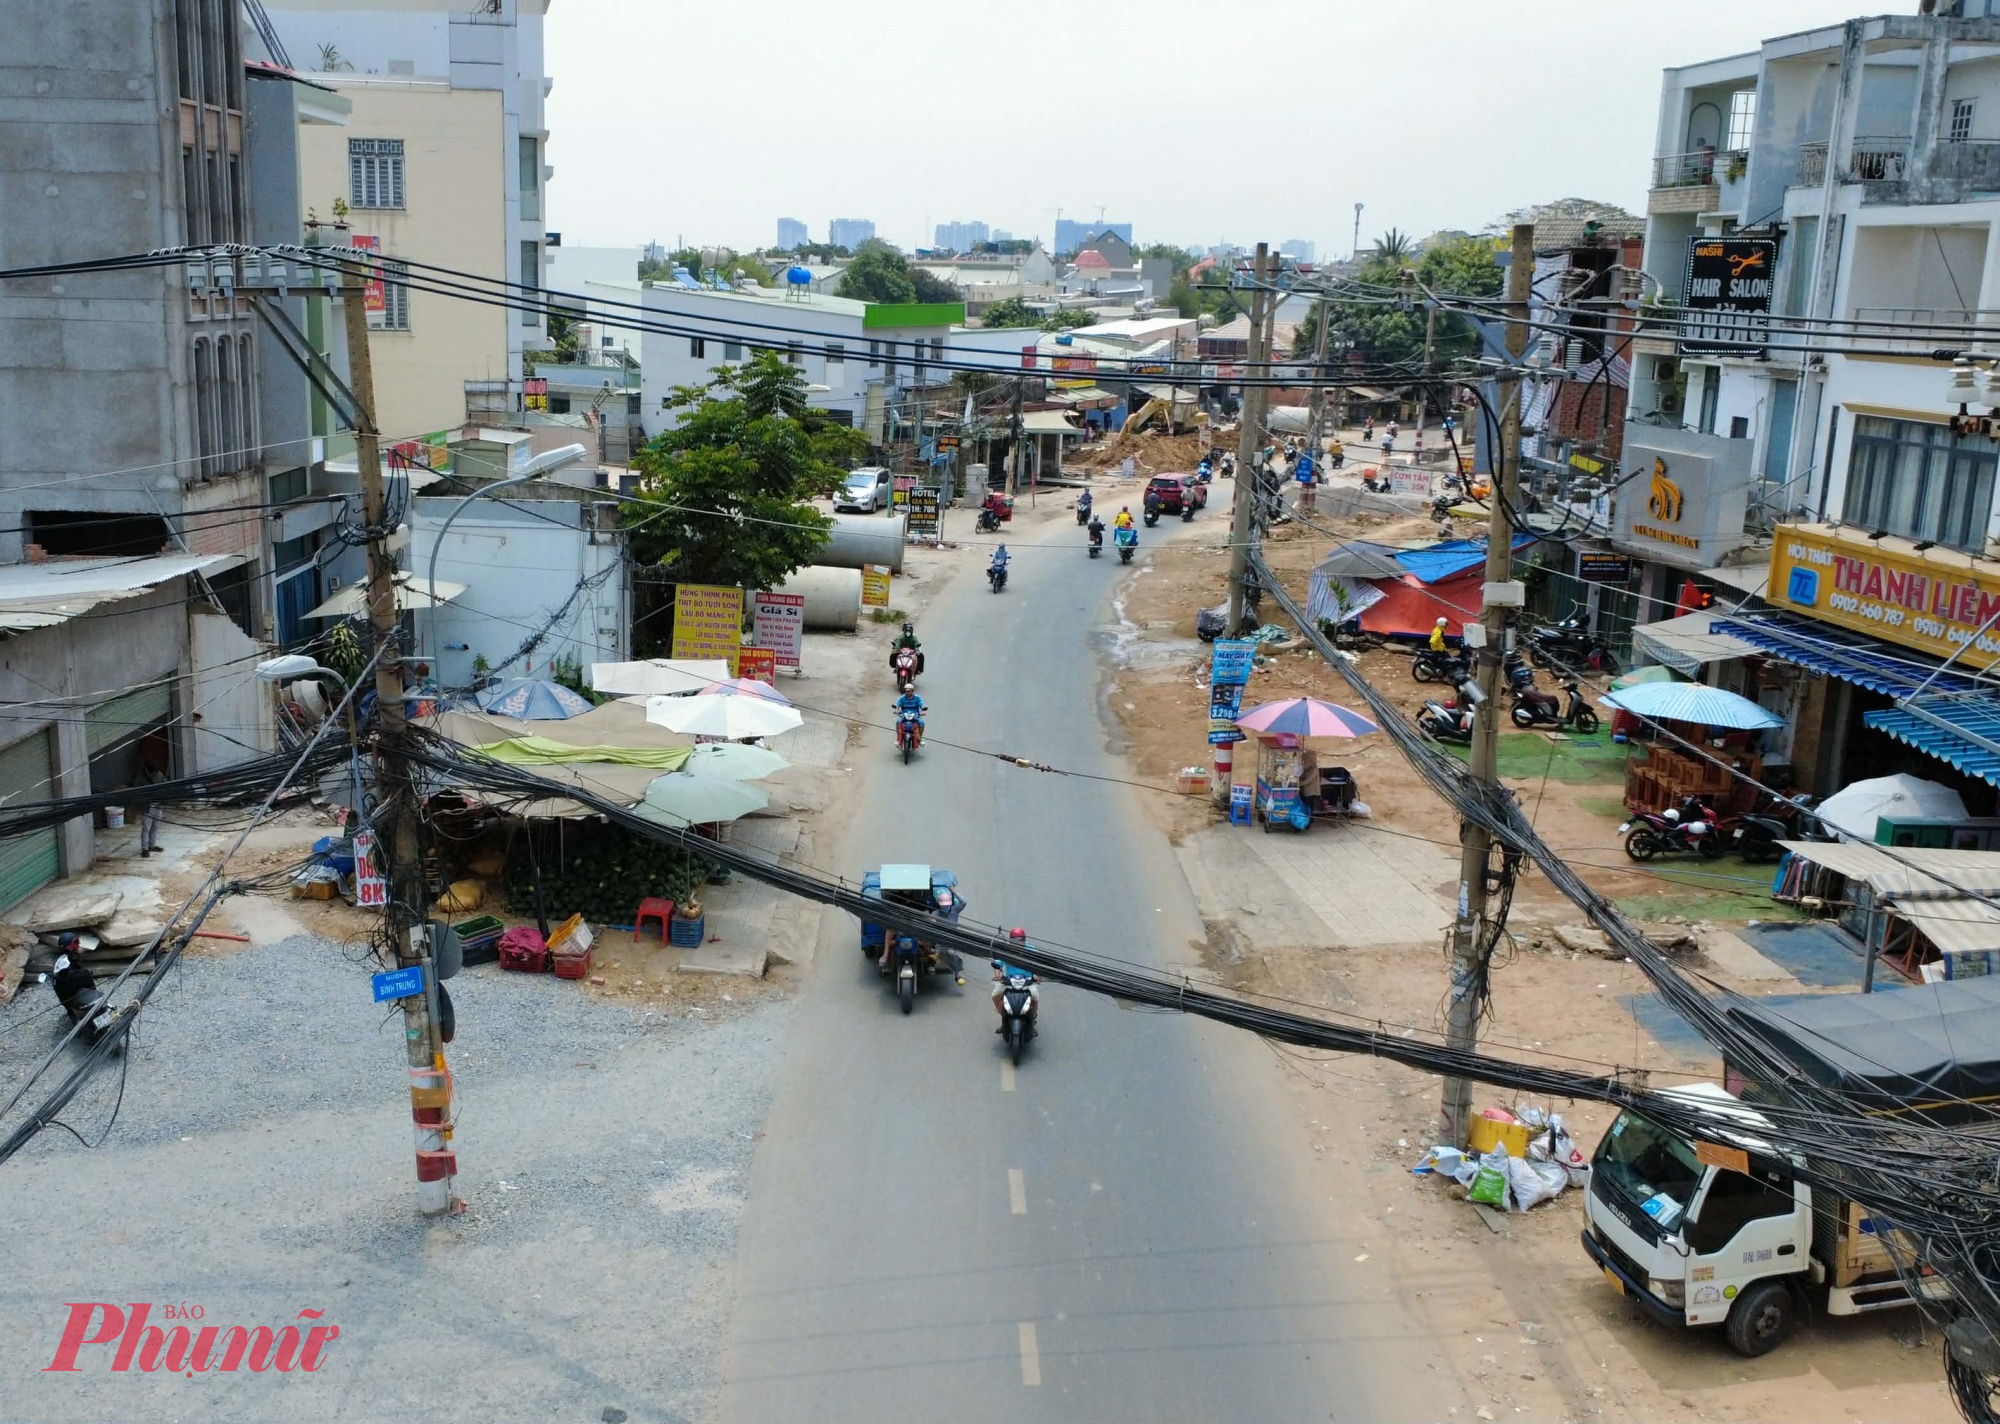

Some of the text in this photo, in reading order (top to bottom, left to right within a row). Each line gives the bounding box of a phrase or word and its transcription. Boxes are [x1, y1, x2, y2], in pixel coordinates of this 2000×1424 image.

[1691, 278, 1769, 298] HAIR SALON
[1394, 471, 1412, 481] CƠM
[911, 489, 937, 498] HOTEL
[1787, 542, 1834, 566] NỘI THẤT
[1792, 571, 1813, 601] TL
[1834, 554, 1930, 612] THANH
[706, 611, 726, 620] MANG
[760, 605, 782, 615] Giá
[1829, 592, 1859, 613] 0902
[1913, 617, 1946, 639] 0907
[360, 883, 385, 904] 8K
[379, 982, 396, 996] BÌNH
[1609, 1201, 1632, 1226] ISUZU
